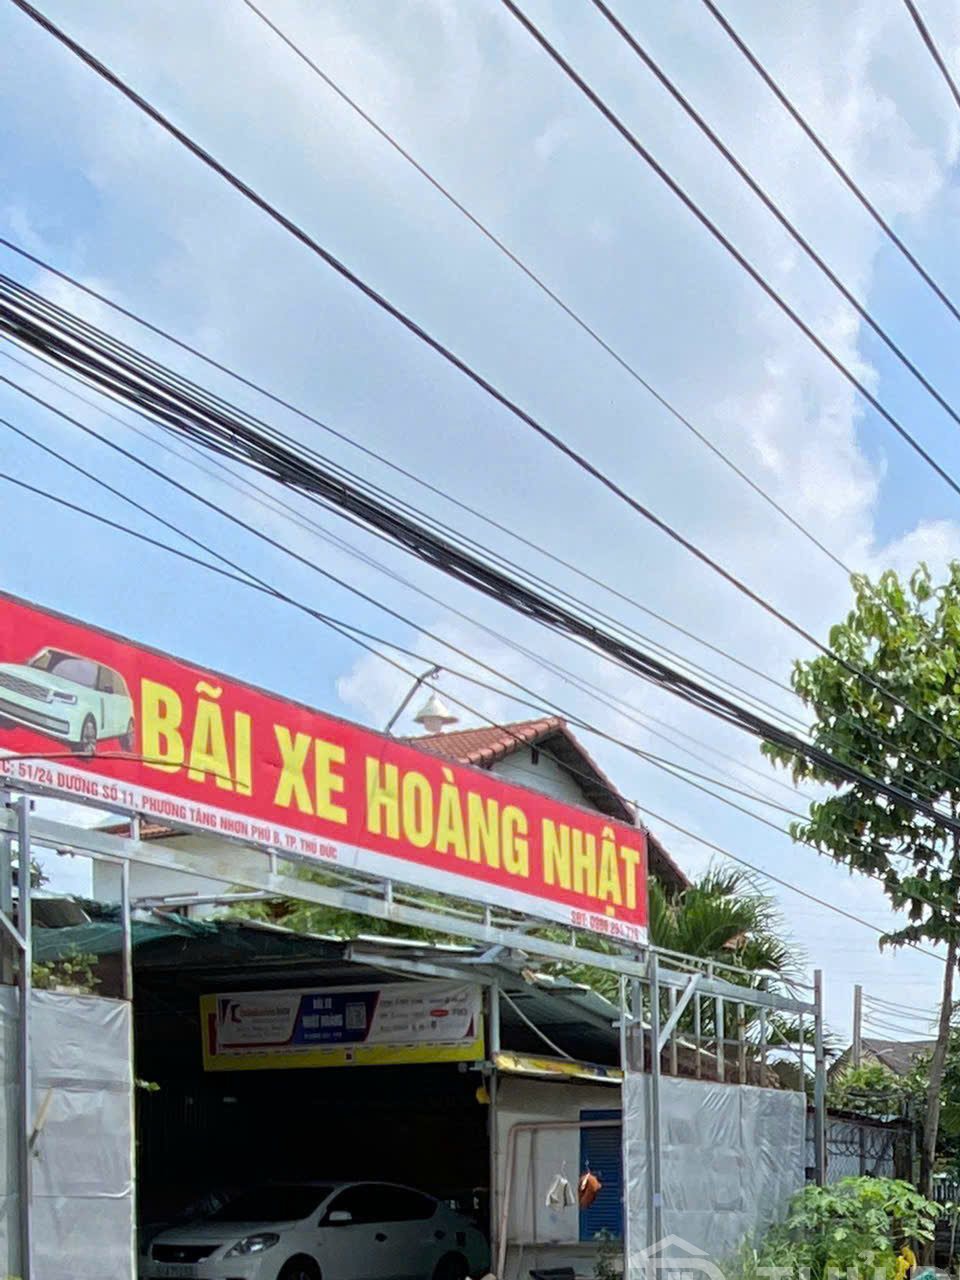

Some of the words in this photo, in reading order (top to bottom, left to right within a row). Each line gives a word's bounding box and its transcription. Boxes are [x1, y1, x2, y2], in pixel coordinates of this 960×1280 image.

[18, 762, 53, 785] 51/24
[140, 677, 253, 797] BÃI
[273, 724, 349, 825] XE
[365, 756, 529, 878] HOÀNG
[542, 818, 641, 917] NHẬT
